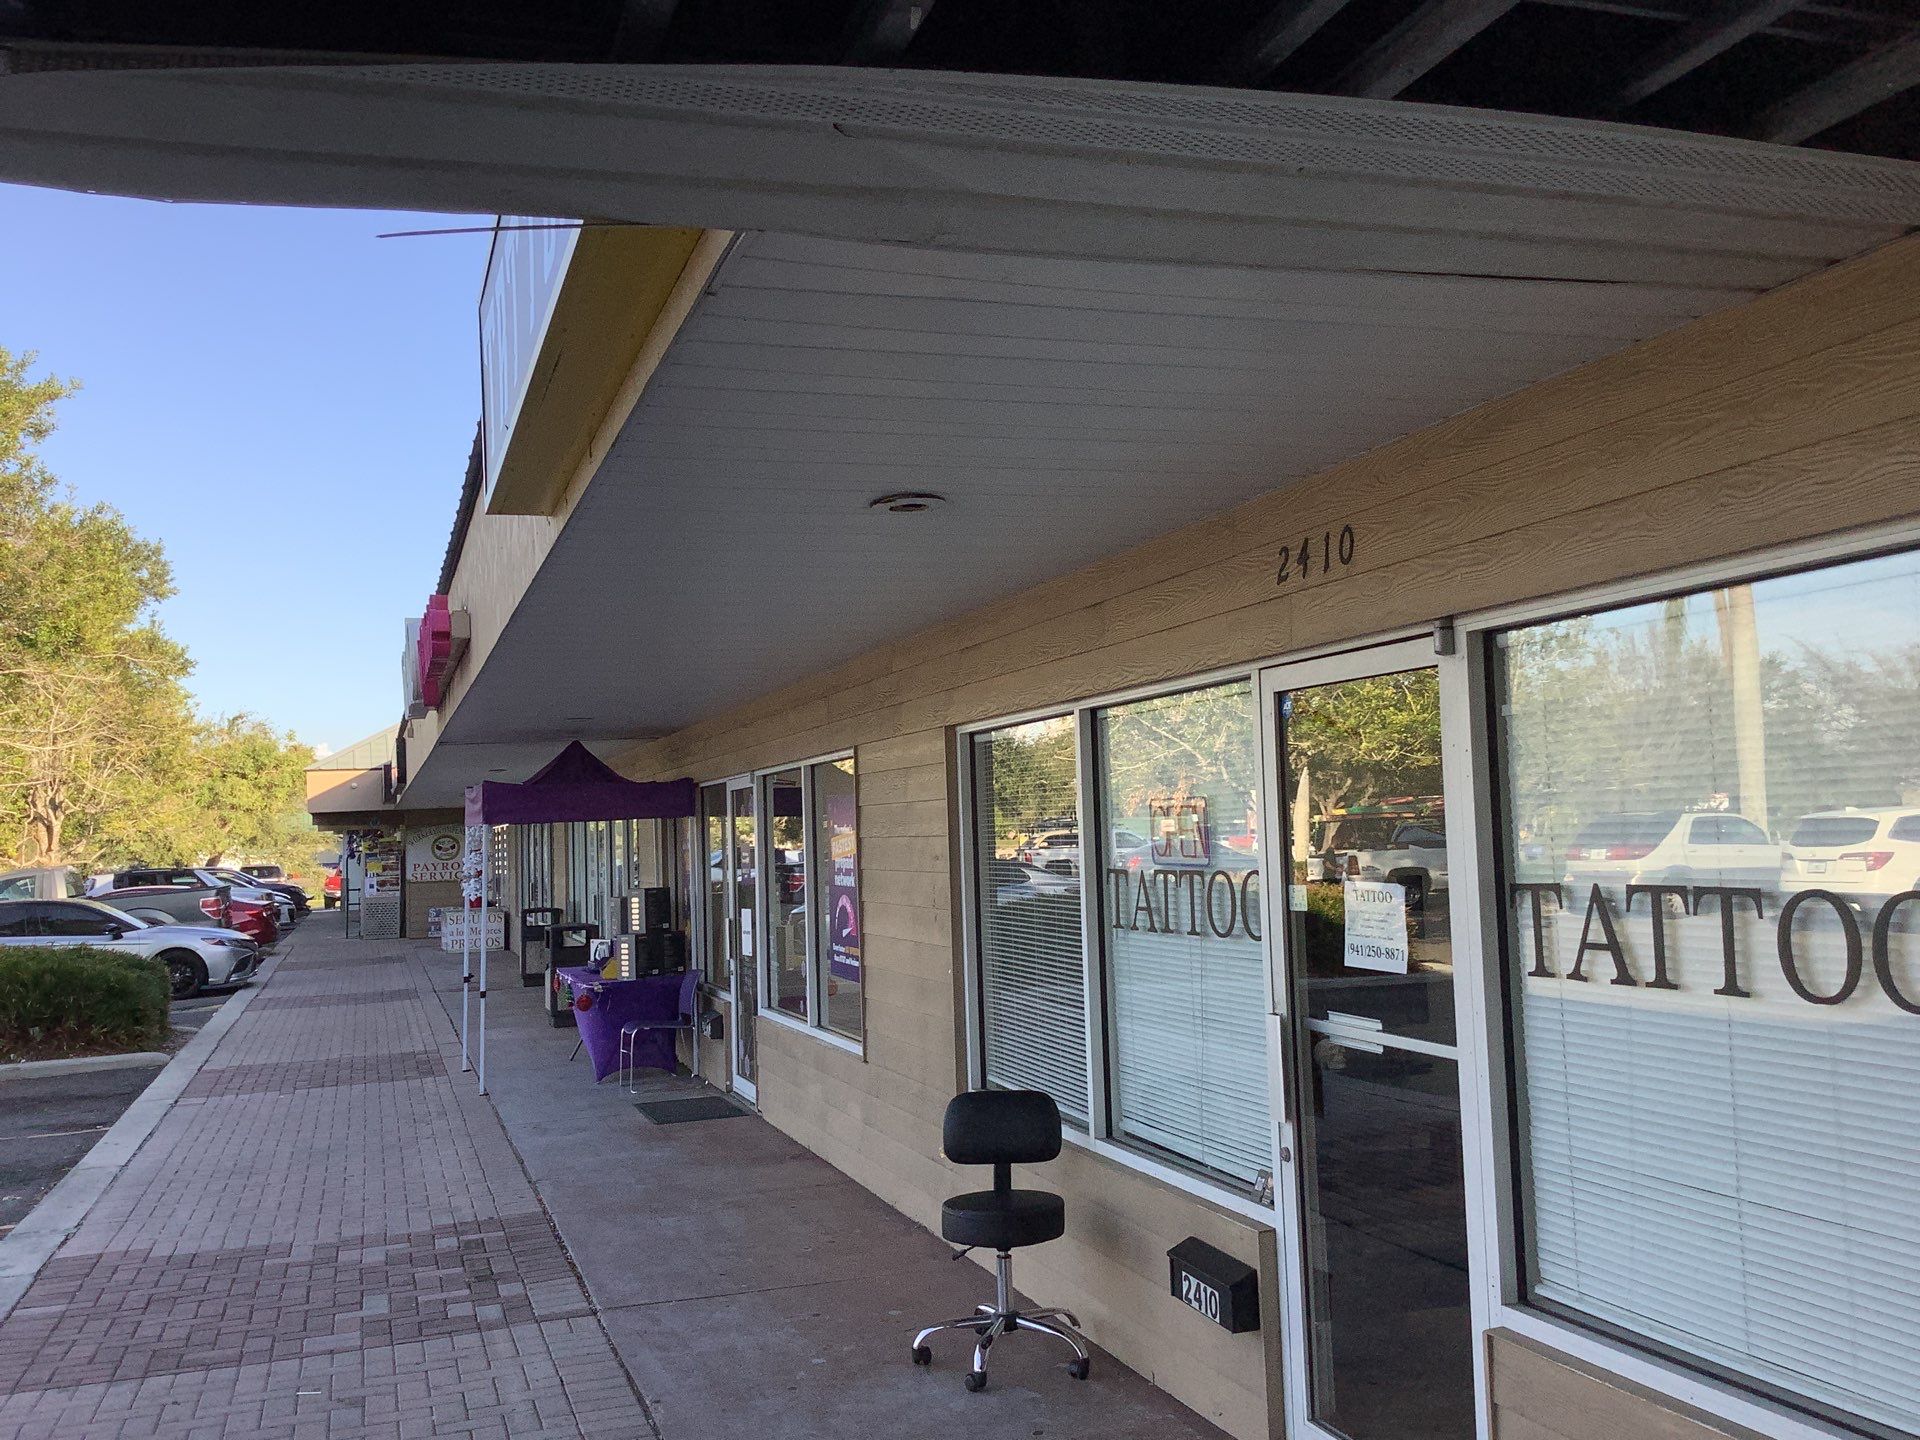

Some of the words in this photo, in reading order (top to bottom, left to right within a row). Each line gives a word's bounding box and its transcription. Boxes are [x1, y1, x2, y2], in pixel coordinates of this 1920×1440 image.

[1277, 524, 1354, 585] 2410
[413, 861, 461, 872] PAYRO
[411, 870, 464, 881] SERVIC
[1352, 889, 1393, 904] TATTOO
[1183, 1274, 1219, 1320] 2410
